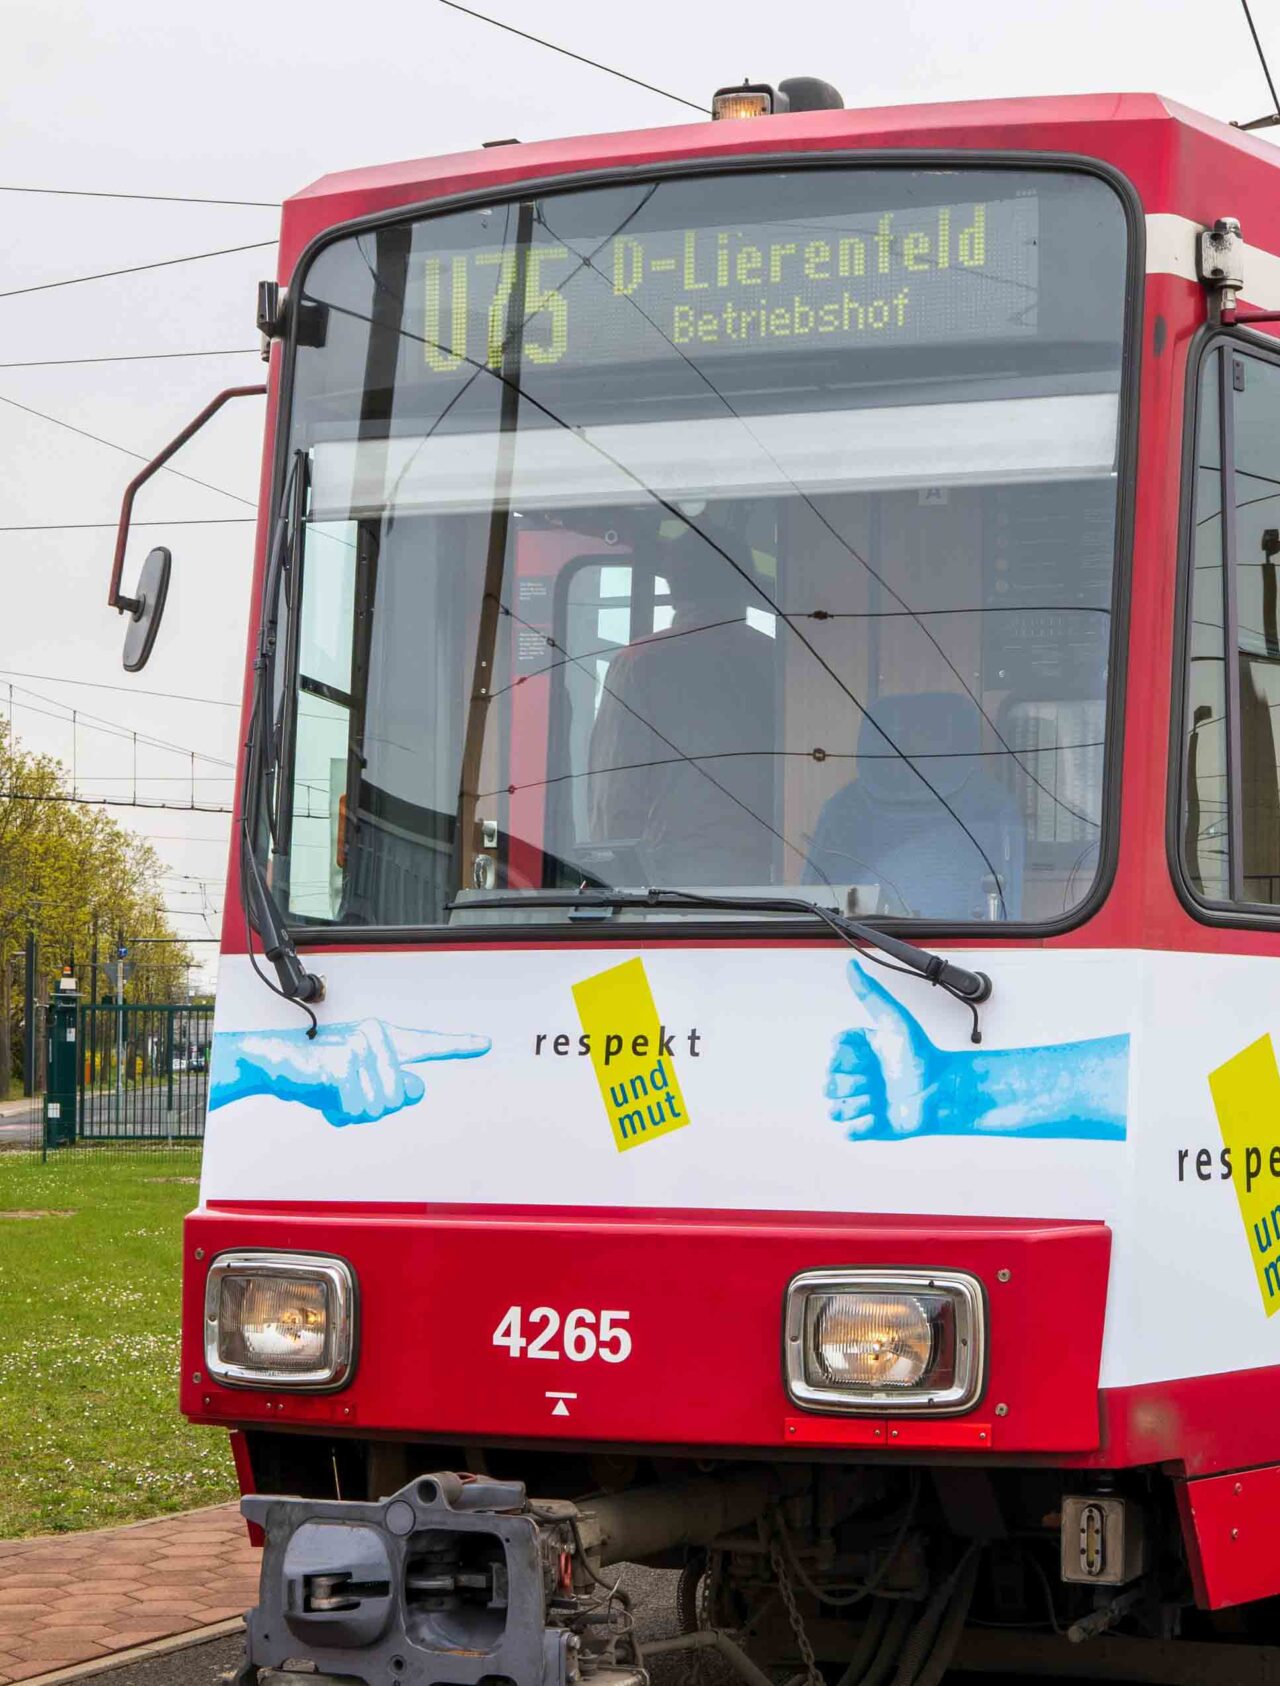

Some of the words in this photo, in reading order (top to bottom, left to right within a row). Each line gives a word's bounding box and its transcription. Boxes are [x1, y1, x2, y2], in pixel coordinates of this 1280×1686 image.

[612, 203, 986, 296] D-Lierenfeld
[425, 247, 568, 372] U75
[673, 286, 909, 344] Betriebshof
[535, 1025, 701, 1066] respekt
[609, 1059, 669, 1108] und
[618, 1091, 681, 1139] mut
[492, 1305, 633, 1363] 4265
